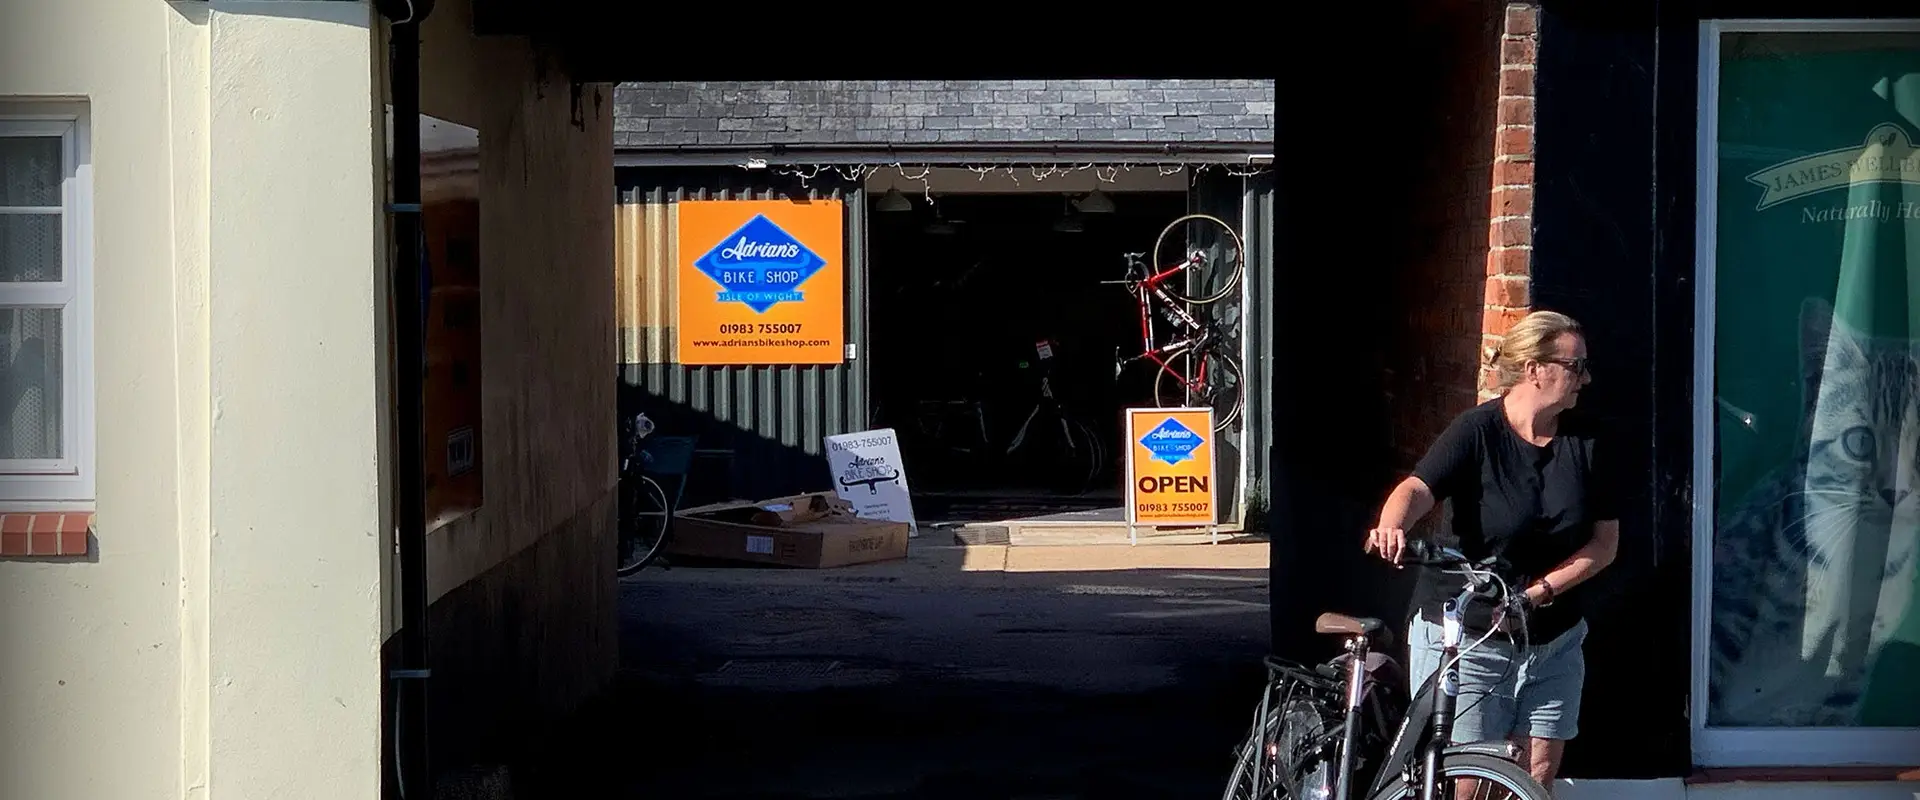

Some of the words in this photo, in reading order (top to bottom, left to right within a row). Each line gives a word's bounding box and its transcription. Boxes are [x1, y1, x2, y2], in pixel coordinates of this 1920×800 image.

[1773, 162, 1843, 193] JAMES
[1846, 155, 1920, 174] WELLB
[1802, 200, 1890, 224] Naturally
[722, 236, 800, 261] Adrian's
[724, 271, 755, 284] BIKE
[766, 271, 799, 284] SHOP
[721, 293, 742, 301] ISLE
[747, 293, 760, 301] OF
[764, 292, 799, 301] WIGHT
[720, 324, 754, 334] 01983
[758, 324, 802, 334] 755007
[693, 338, 830, 348] www.adriansbikeshop.com
[1174, 444, 1191, 452] SHOP
[866, 464, 893, 478] SHOP
[1138, 475, 1208, 494] OPEN
[1139, 503, 1168, 512] 01983
[1172, 502, 1208, 512] 755007
